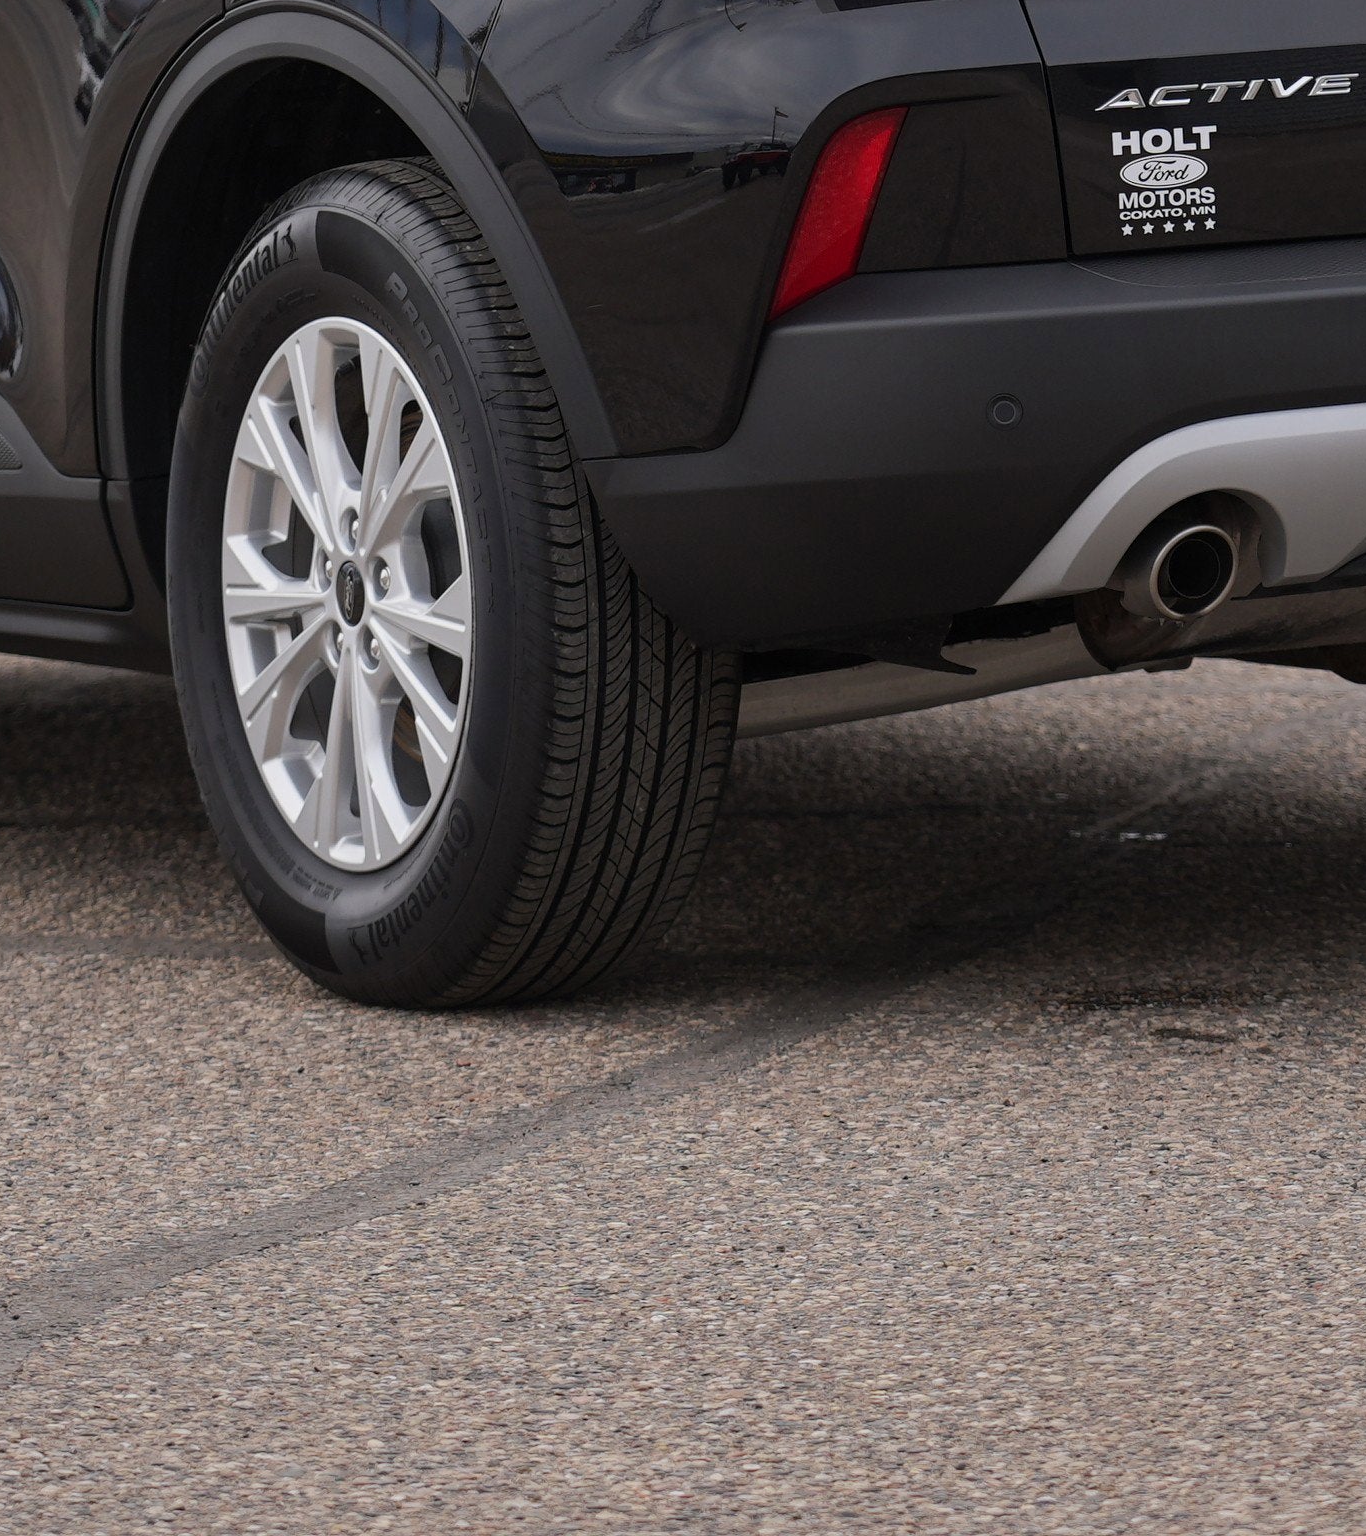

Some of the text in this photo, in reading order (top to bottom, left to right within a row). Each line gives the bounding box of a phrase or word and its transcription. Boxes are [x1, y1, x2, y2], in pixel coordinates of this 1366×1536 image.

[1094, 72, 1360, 112] ACTIVE
[1111, 125, 1218, 156] HOLT
[1138, 160, 1190, 182] Ford
[1118, 186, 1216, 210] MOTORS
[1119, 205, 1216, 221] COKATO, MN
